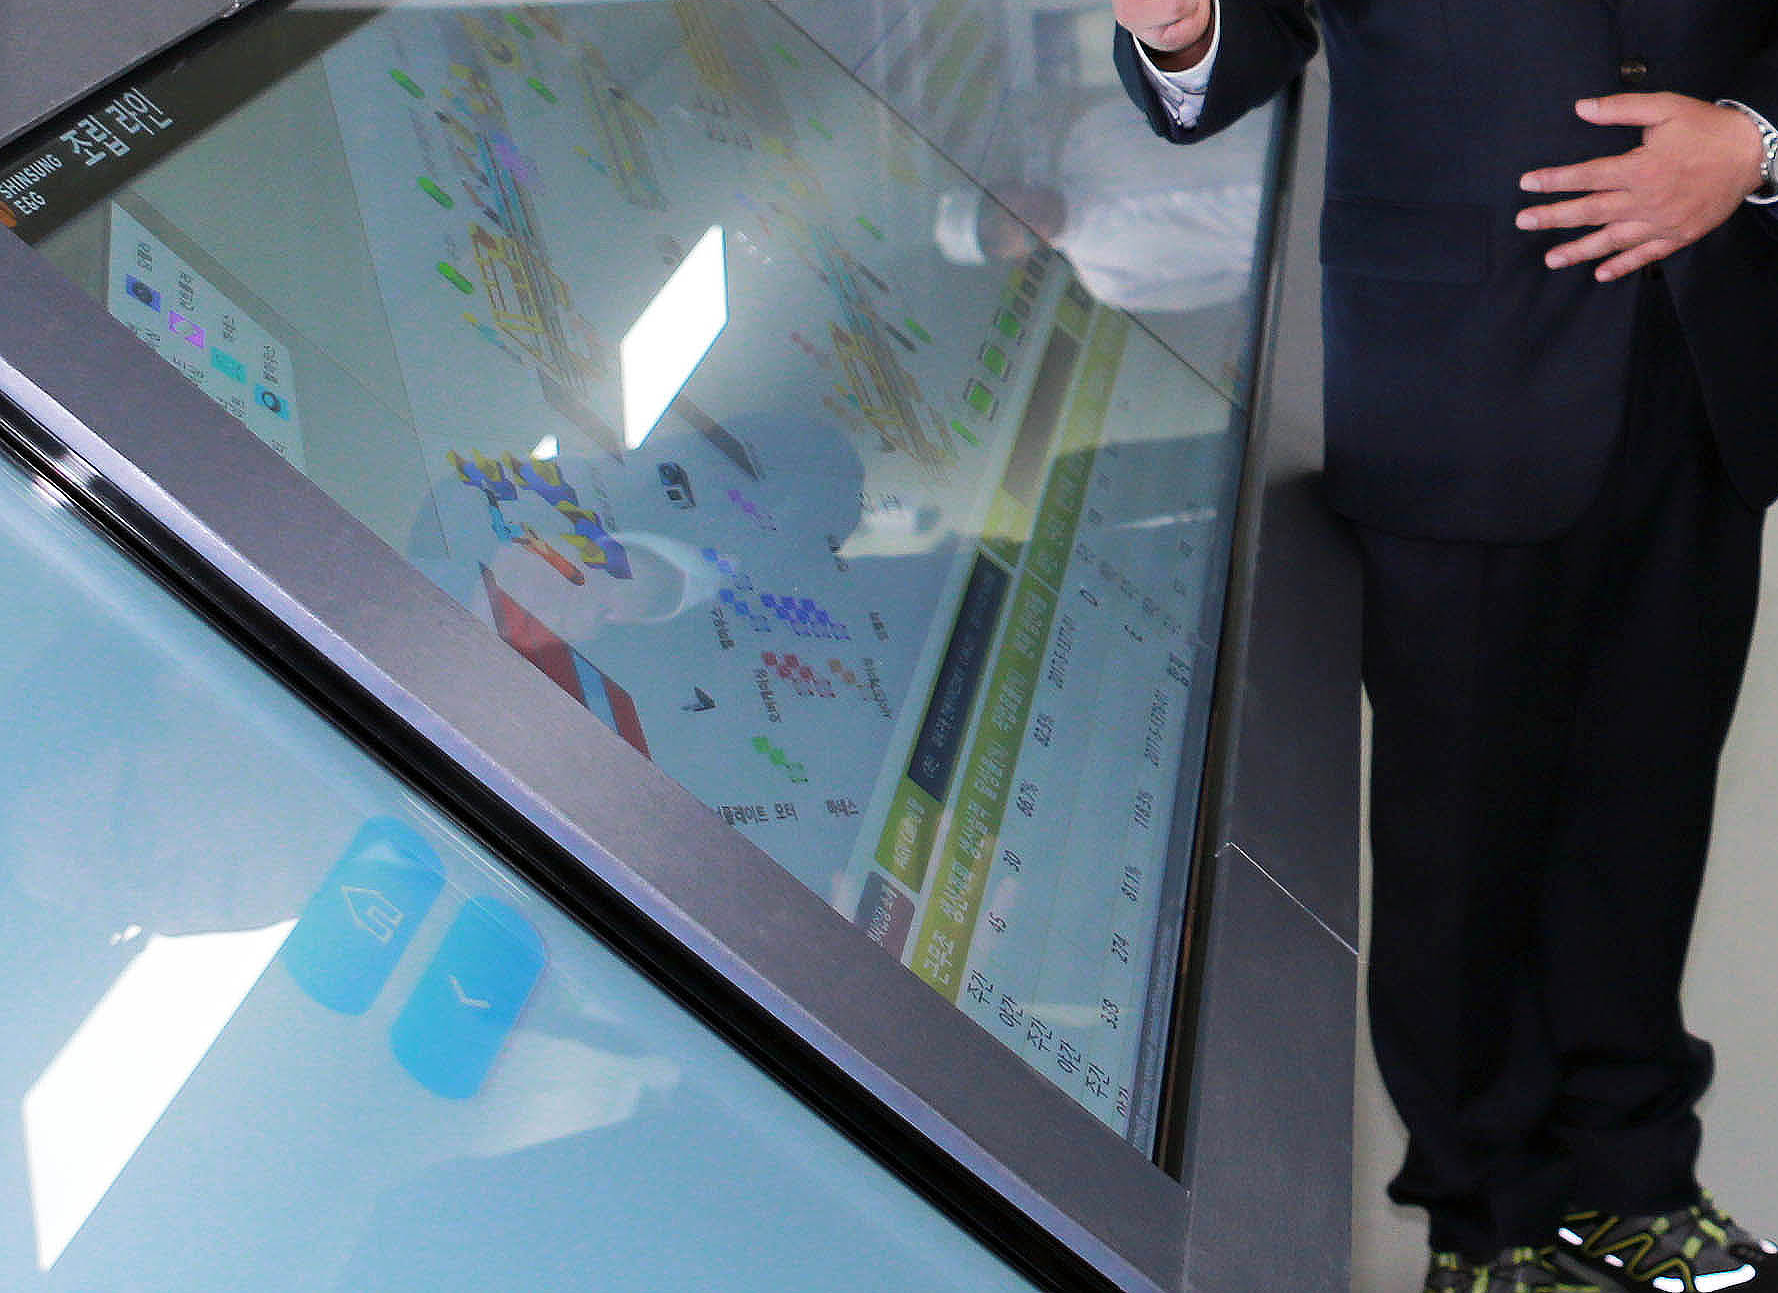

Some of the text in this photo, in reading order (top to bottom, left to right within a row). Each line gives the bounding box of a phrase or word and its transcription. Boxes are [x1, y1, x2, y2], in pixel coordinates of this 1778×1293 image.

[59, 86, 174, 167] 조립 라인
[0, 153, 64, 200] SHINSUNG
[13, 191, 47, 216] E&G
[717, 802, 769, 827] 플레이트
[1002, 849, 1022, 873] 30
[988, 911, 1008, 933] 45
[967, 968, 994, 1004] 주간
[999, 993, 1024, 1028] 야간
[1026, 1016, 1053, 1052] 주간
[1056, 1038, 1081, 1074] 야간
[1085, 1062, 1111, 1099] 주간
